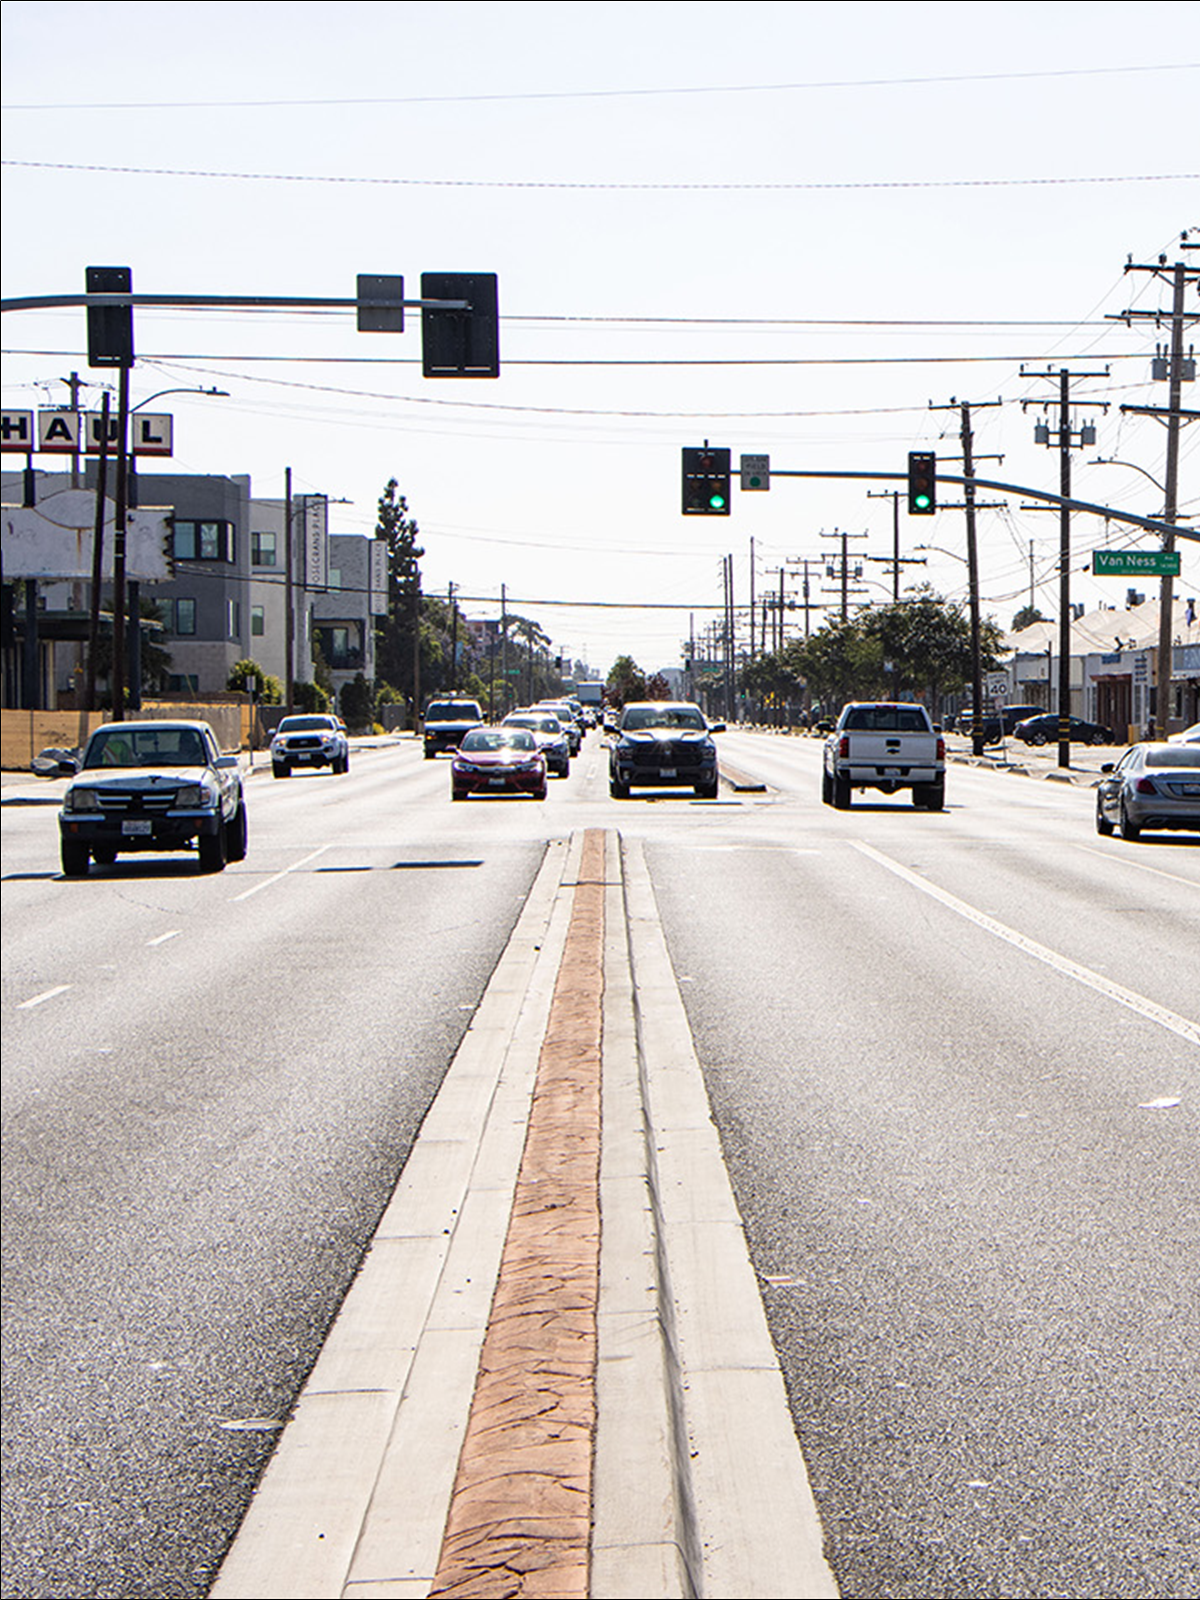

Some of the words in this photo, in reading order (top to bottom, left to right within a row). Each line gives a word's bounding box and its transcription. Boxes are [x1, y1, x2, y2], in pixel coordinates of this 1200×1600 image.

[1099, 555, 1123, 566] Van
[1126, 556, 1156, 567] Ness
[991, 684, 1006, 693] 40
